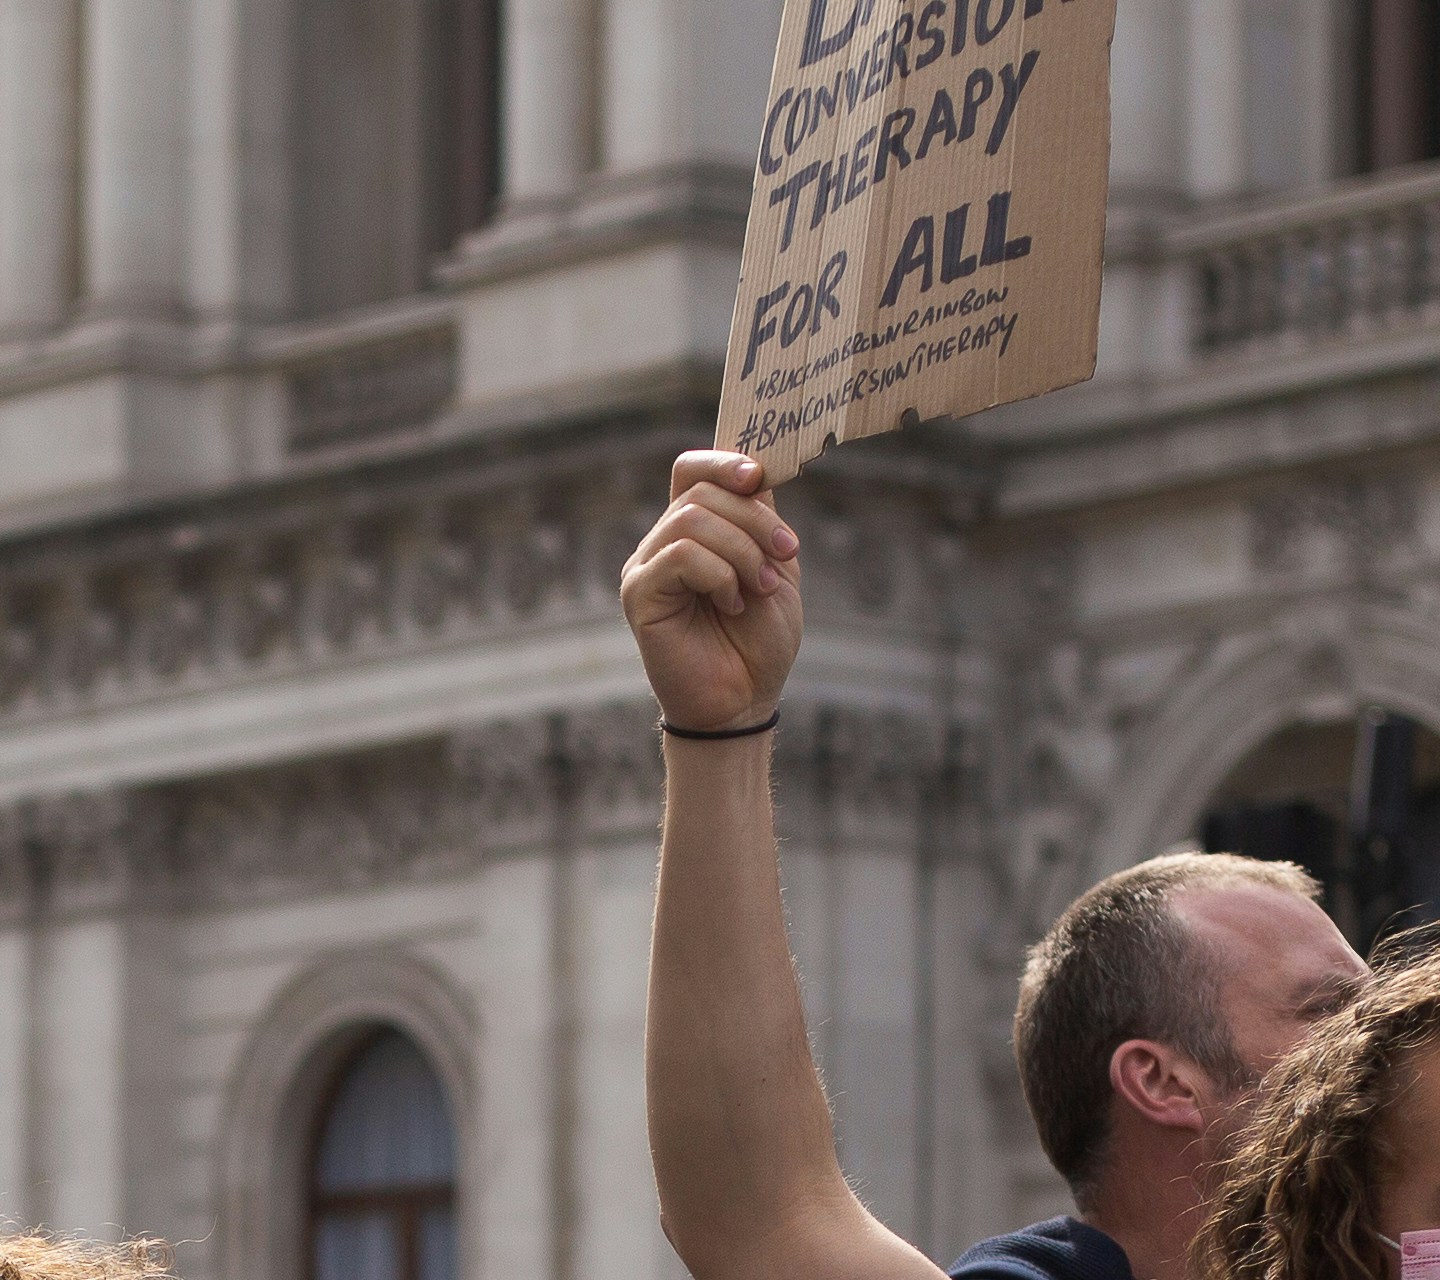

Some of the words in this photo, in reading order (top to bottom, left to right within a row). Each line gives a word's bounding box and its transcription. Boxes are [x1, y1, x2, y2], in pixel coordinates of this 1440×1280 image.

[759, 0, 1072, 176] CONVERSIO
[769, 50, 1040, 253] THERAPY
[741, 250, 847, 380] FOR
[879, 191, 1031, 309] ALL
